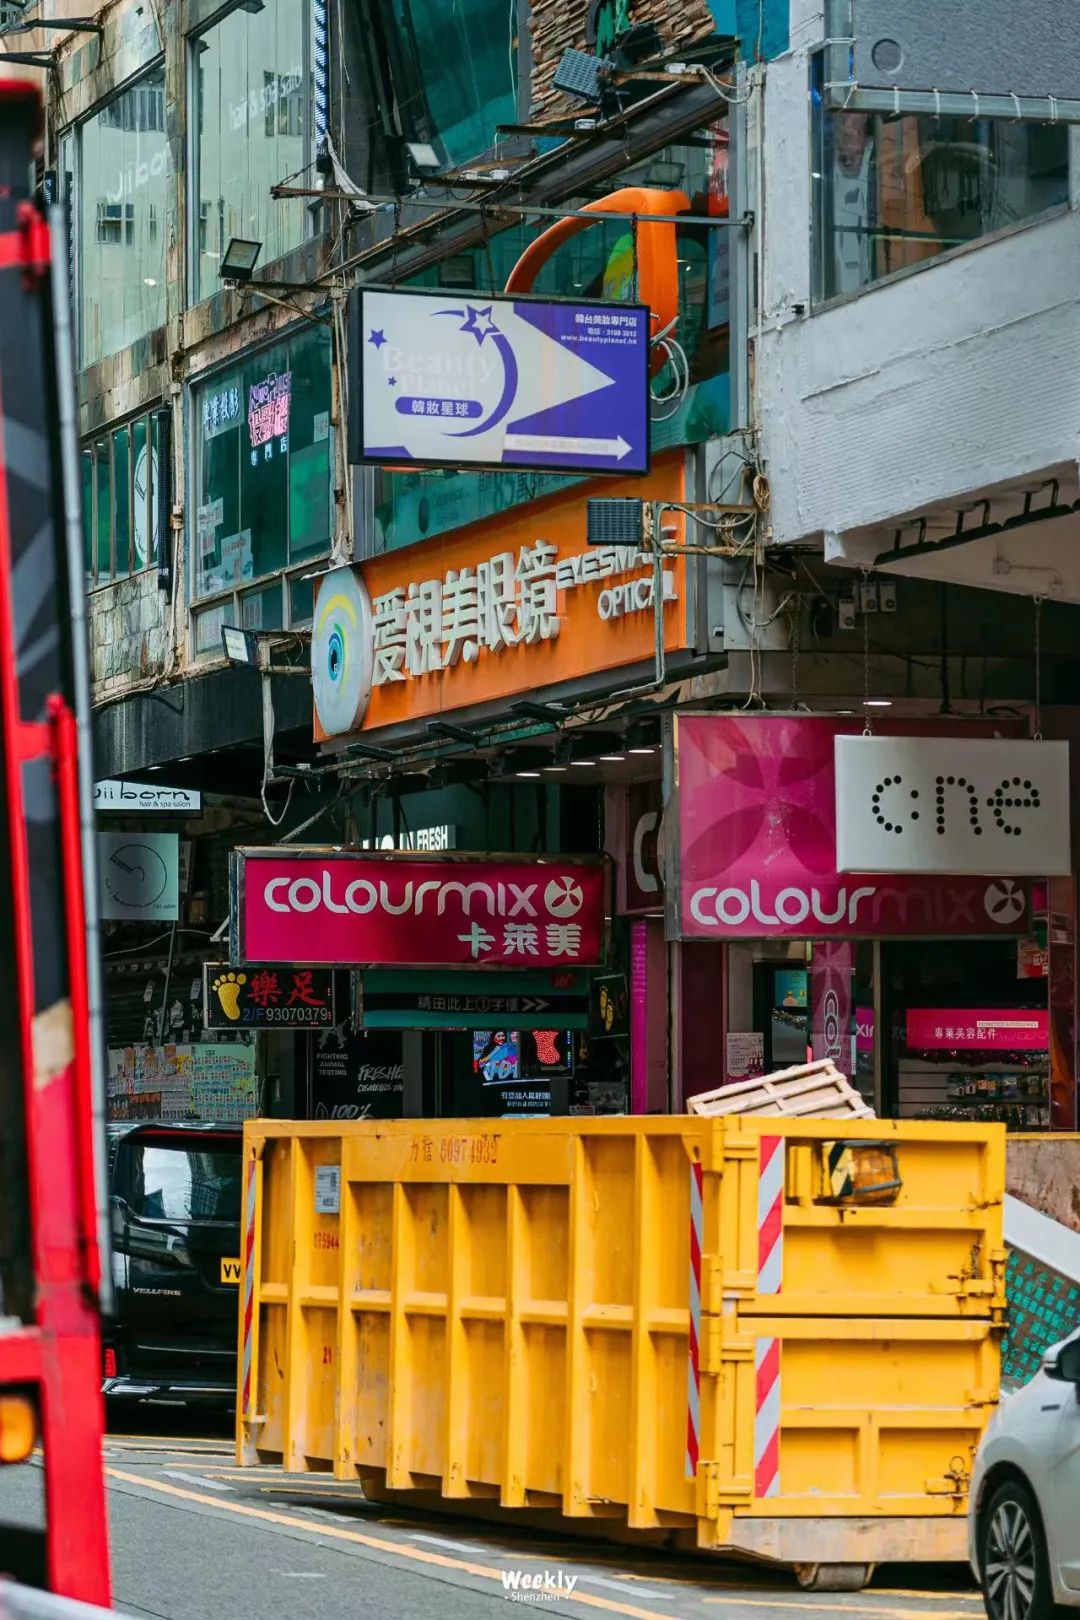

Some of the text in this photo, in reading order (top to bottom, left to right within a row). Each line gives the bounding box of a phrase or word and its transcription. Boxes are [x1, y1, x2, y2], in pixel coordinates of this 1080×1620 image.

[383, 346, 495, 384] Beauty
[411, 399, 469, 416] 韓妝星球
[417, 825, 448, 851] FRESH
[263, 870, 539, 917] colourmix
[457, 921, 582, 959] 卡萊美
[247, 970, 326, 1008] 樂足
[132, 1286, 183, 1297] VELLFIRE
